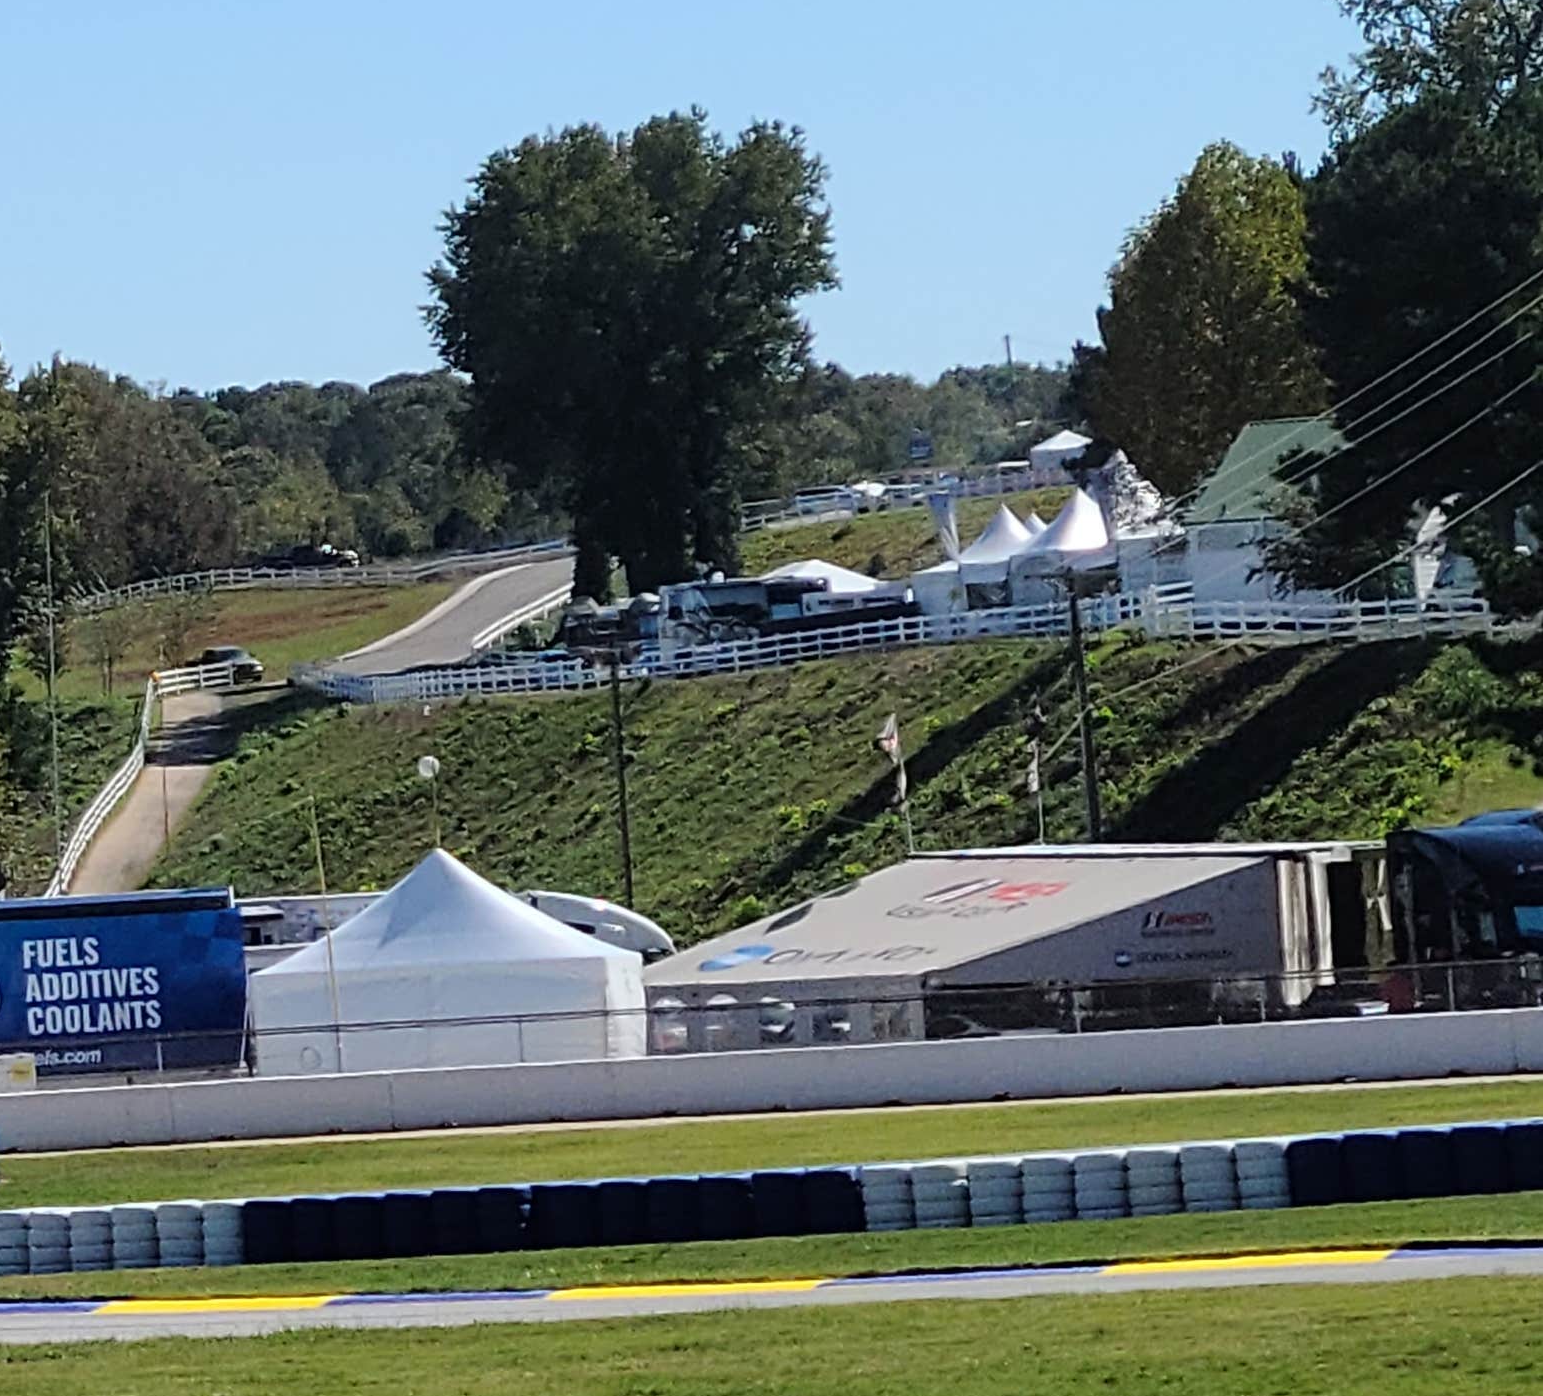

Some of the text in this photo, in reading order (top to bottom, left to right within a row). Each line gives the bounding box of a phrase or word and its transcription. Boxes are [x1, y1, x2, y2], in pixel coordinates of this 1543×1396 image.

[23, 937, 100, 969] FUELS
[25, 967, 161, 1003] ADDITIVES
[27, 1000, 162, 1035] COOLANTS
